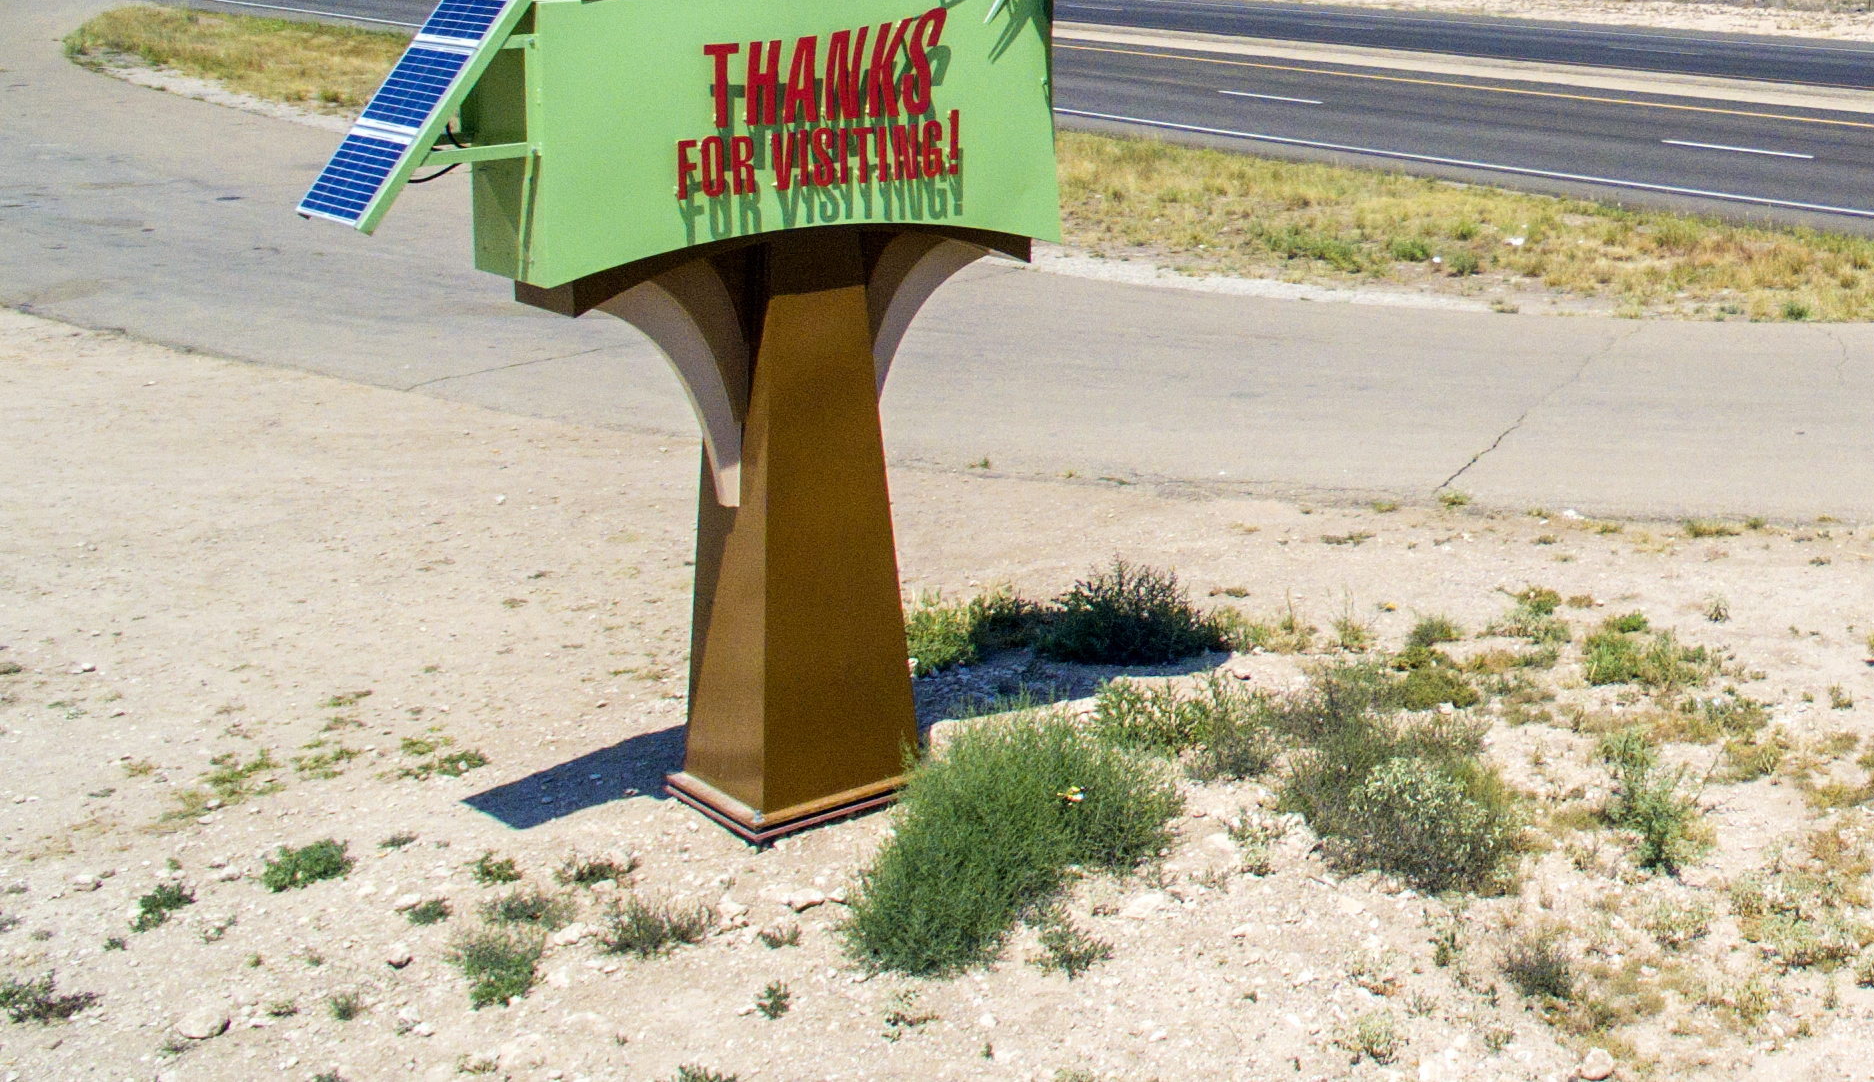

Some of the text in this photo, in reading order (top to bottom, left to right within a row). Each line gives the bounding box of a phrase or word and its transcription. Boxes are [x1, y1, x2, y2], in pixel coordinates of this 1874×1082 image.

[703, 7, 947, 128] THANKS
[677, 109, 959, 200] FOR VISITING!
